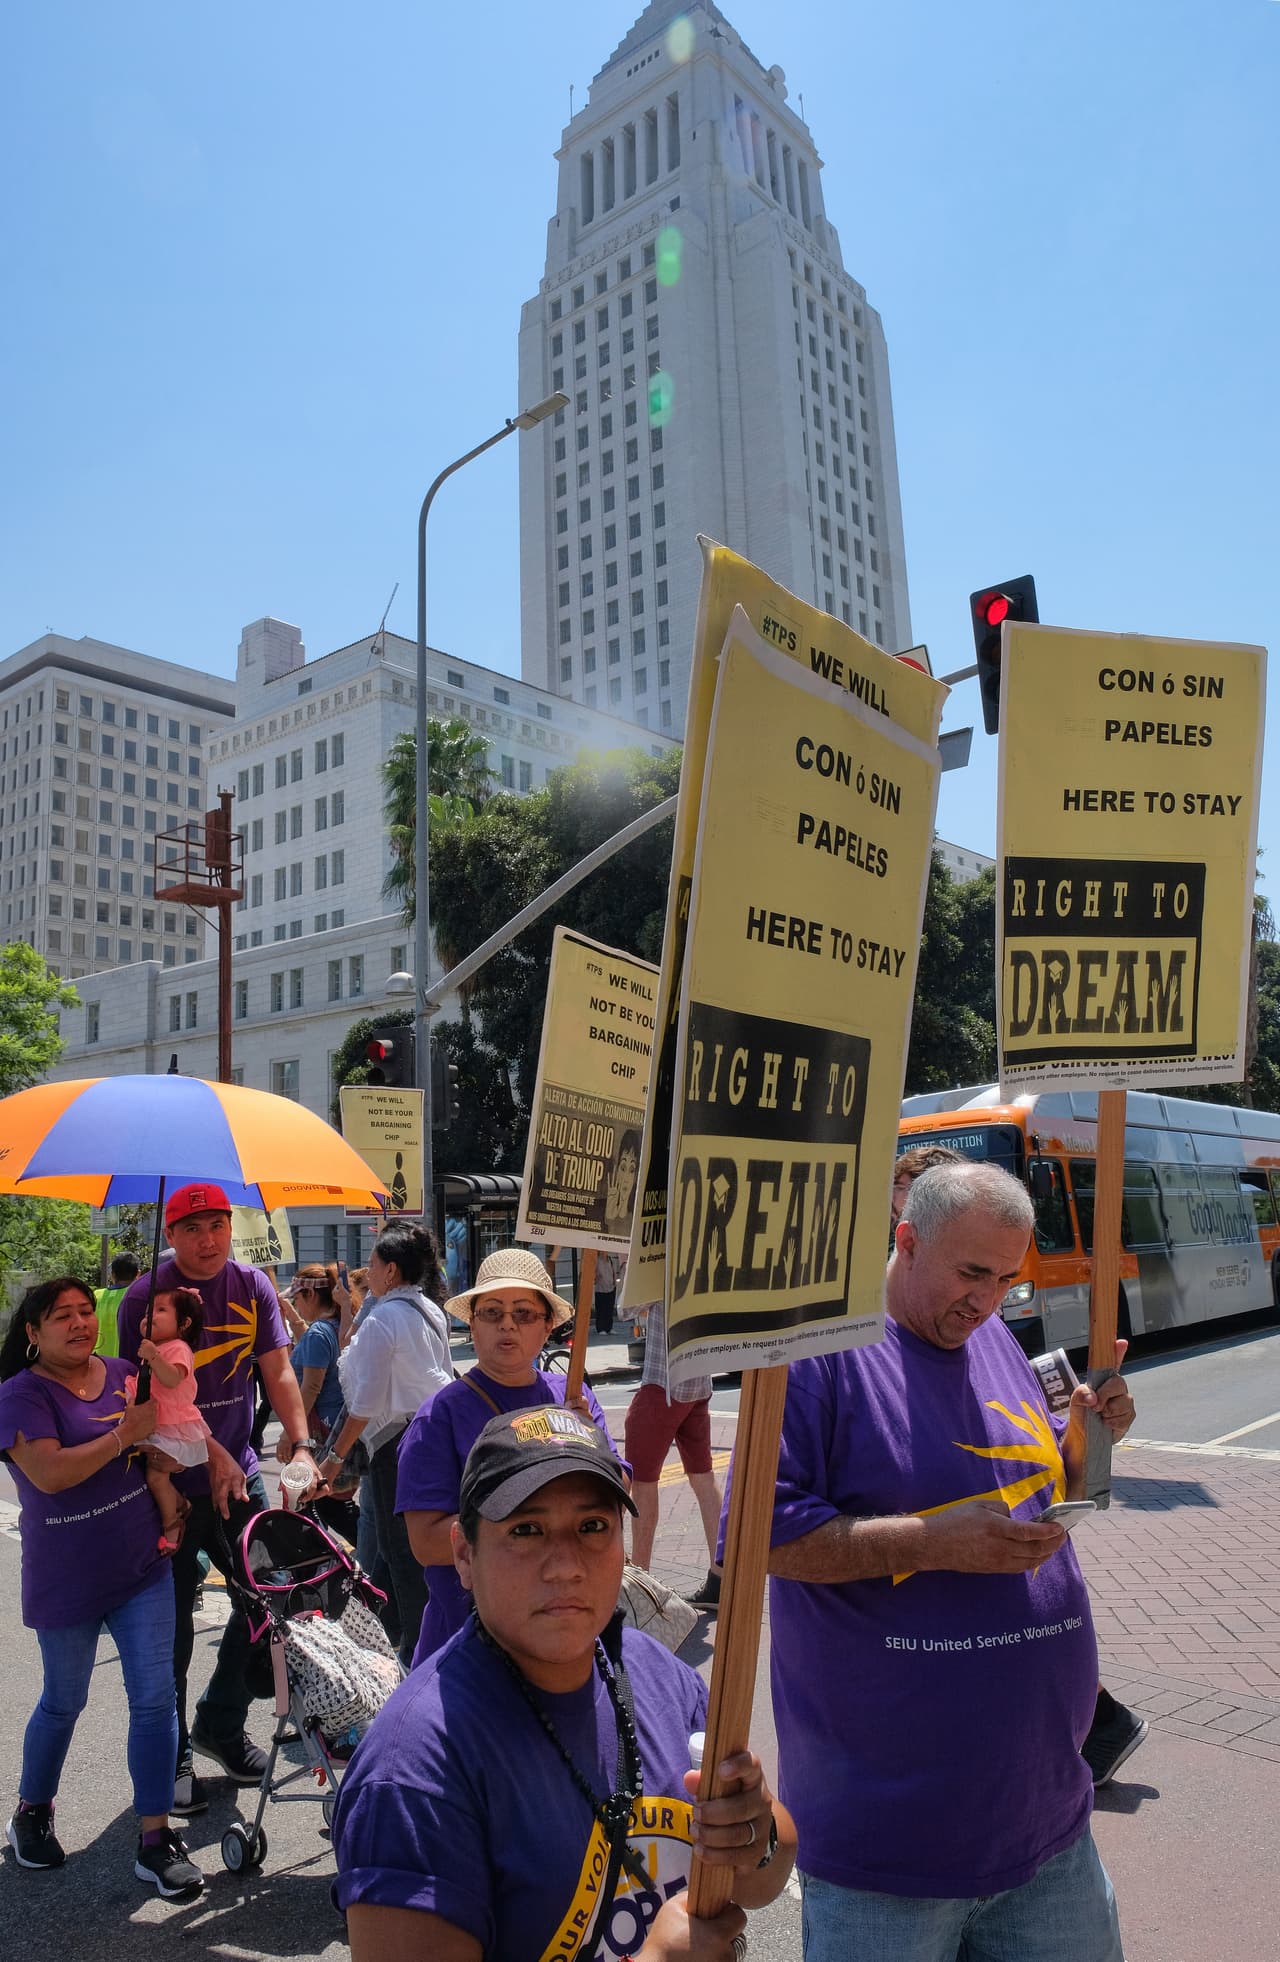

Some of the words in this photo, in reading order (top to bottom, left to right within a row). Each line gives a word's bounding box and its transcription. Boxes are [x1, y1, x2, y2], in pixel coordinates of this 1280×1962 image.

[762, 615, 796, 651] #TPS
[810, 647, 844, 687] WE
[848, 669, 890, 716] WILL
[1098, 667, 1154, 692] CON
[1163, 673, 1174, 695] ó
[1183, 674, 1224, 699] SIN
[1105, 720, 1213, 747] PAPELES
[796, 736, 851, 786] CON
[856, 765, 865, 795] ó
[870, 773, 901, 816] SIN
[1063, 789, 1135, 813] HERE
[1144, 791, 1175, 814] TO
[1183, 793, 1242, 817] STAY
[797, 812, 888, 878] PAPELES
[1012, 879, 1128, 918] RIGHT
[1153, 882, 1189, 919] TO
[746, 906, 823, 955] HERE
[831, 927, 853, 963] TO
[857, 937, 906, 978] STAY
[587, 963, 602, 976] #TPS
[609, 973, 628, 990] WE
[630, 980, 653, 1001] WILL
[1010, 949, 1187, 1037] DREAM
[590, 996, 616, 1015] NOT
[619, 1005, 633, 1021] BE
[636, 1011, 656, 1030] YOU
[611, 1061, 636, 1080] CHIP
[688, 1040, 810, 1111] RIGHT
[826, 1063, 856, 1117] TO
[368, 1108, 383, 1116] NOT
[544, 1087, 567, 1108] ALERTA
[568, 1094, 577, 1109] DE
[370, 1121, 412, 1129] BARGAINING
[539, 1111, 568, 1149] ALTO
[568, 1118, 583, 1153] AL
[585, 1122, 614, 1159] ODIO
[940, 1134, 983, 1150] STATION
[544, 1151, 560, 1185] DE
[562, 1154, 604, 1192] TRUMP
[530, 1227, 546, 1235] SEIU
[673, 1156, 848, 1302] DREAM
[249, 1247, 272, 1264] DACA
[694, 1348, 709, 1357] other
[709, 1343, 741, 1354] employer.
[742, 1341, 751, 1349] No
[752, 1338, 777, 1350] request
[826, 1328, 835, 1336] stop
[63, 1511, 91, 1523] United
[92, 1501, 119, 1516] Service
[885, 1637, 917, 1650] SEIU
[922, 1637, 972, 1652] United
[976, 1631, 1021, 1649] Service
[1023, 1622, 1063, 1641] Workers
[1063, 1616, 1083, 1630] West
